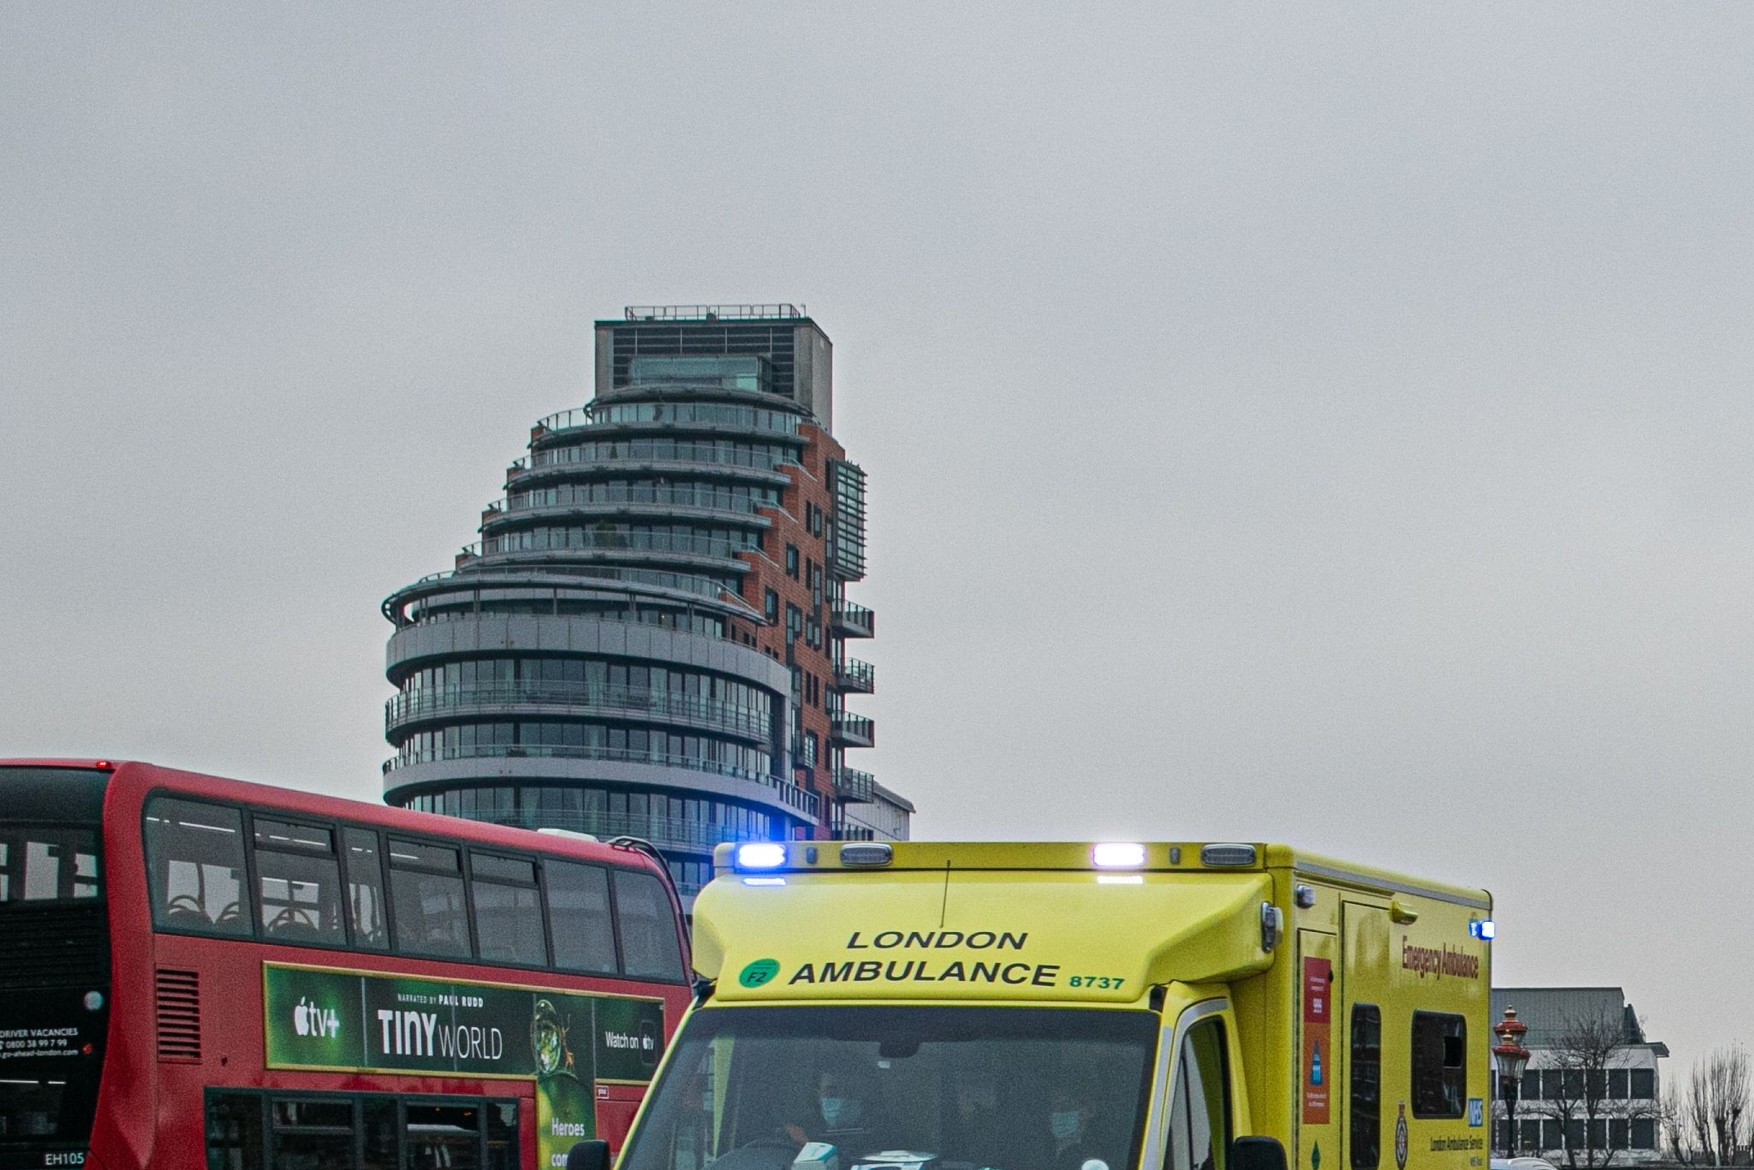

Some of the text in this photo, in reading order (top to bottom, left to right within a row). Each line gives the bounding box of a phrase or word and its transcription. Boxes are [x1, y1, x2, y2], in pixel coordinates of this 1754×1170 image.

[847, 931, 1028, 950] LONDON
[1403, 935, 1478, 980] Emergency Ambulance
[746, 971, 767, 983] F2
[788, 961, 1060, 987] AMBULANCE
[1069, 976, 1125, 990] 8737
[398, 993, 484, 1008] NARRATED BY PAUL RUDD
[309, 1001, 340, 1039] tv+
[0, 1027, 78, 1038] DRIVER VACANCIES
[377, 1009, 503, 1060] TINY WORLD
[605, 1031, 629, 1048] Watch
[630, 1036, 639, 1049] on
[5, 1039, 68, 1049] 0800 38 99 7 99
[1469, 1100, 1483, 1125] NHS
[551, 1118, 585, 1136] Heroes
[45, 1152, 85, 1165] EH105
